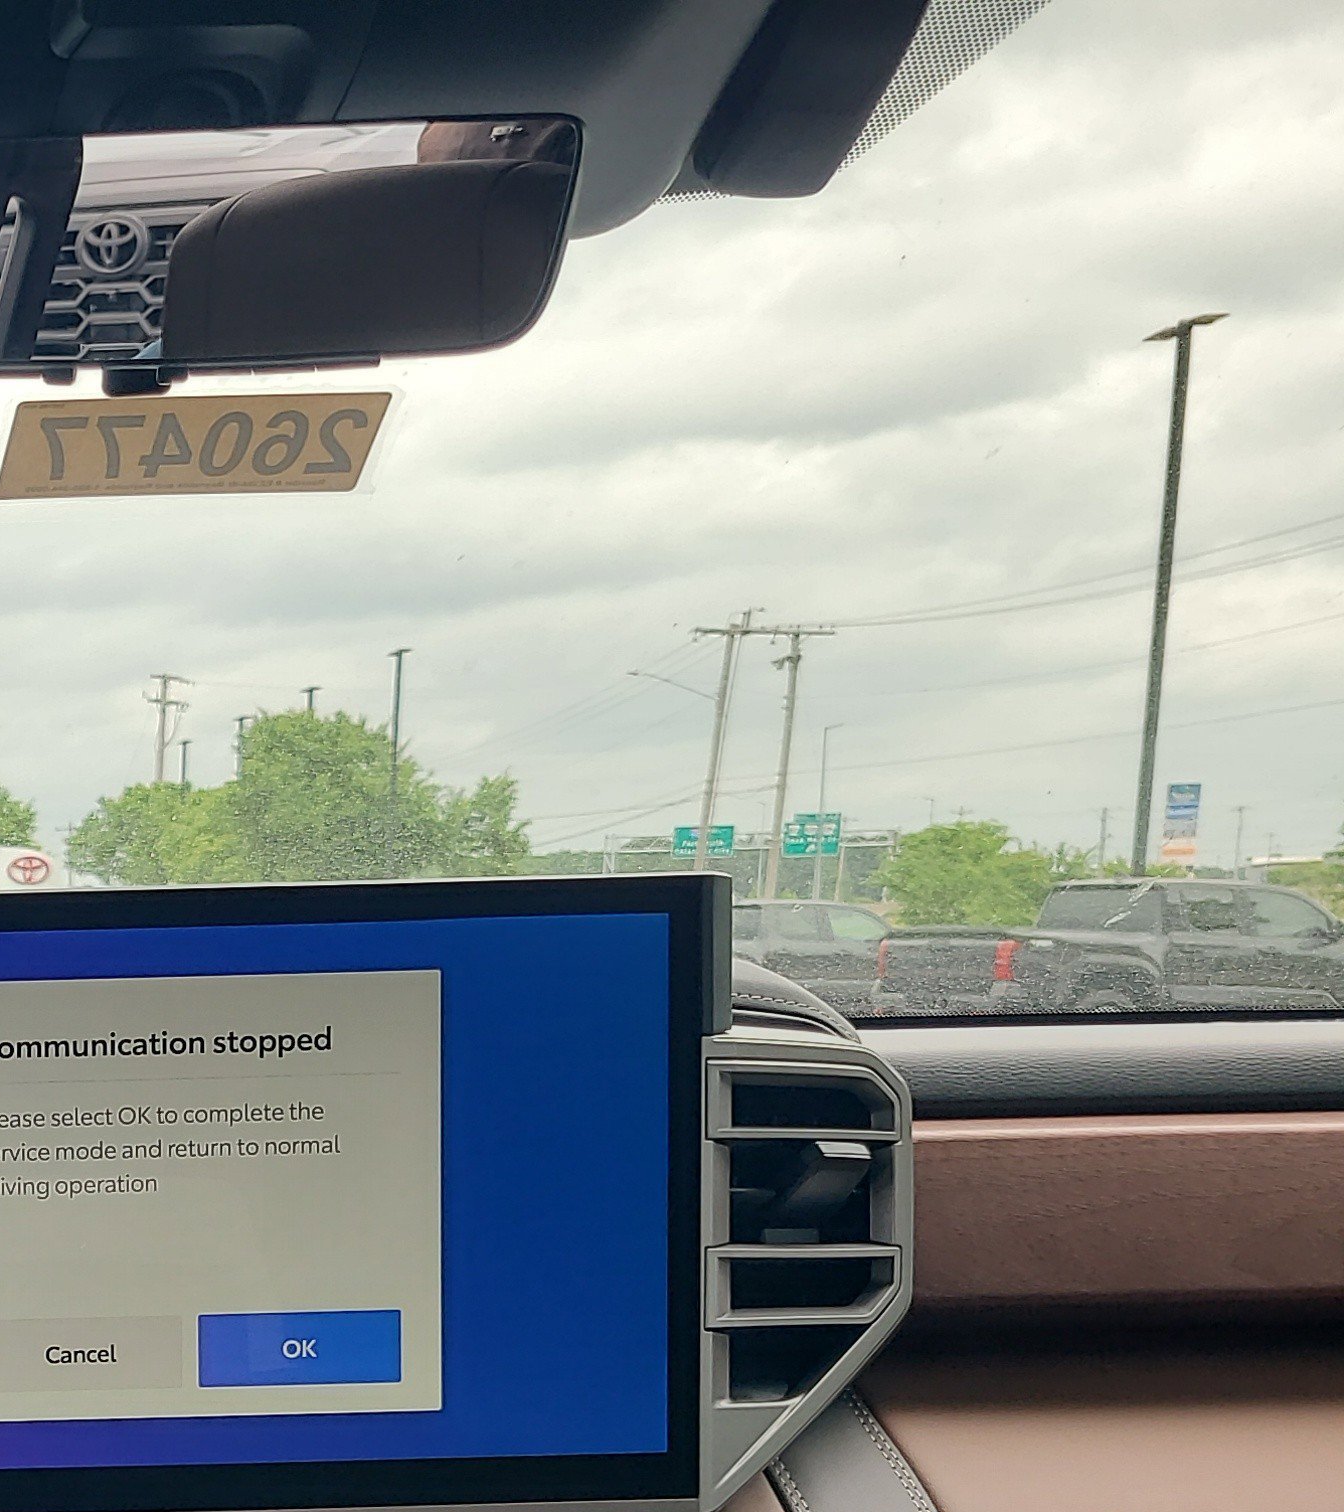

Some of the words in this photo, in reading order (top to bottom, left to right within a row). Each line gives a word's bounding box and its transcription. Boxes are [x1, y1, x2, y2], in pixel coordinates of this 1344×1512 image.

[212, 1026, 333, 1060] stopped
[50, 1107, 114, 1127] select
[118, 1106, 152, 1126] OK
[156, 1107, 178, 1125] to
[183, 1104, 286, 1128] complete
[289, 1102, 325, 1121] the
[55, 1140, 117, 1161] mode
[121, 1139, 162, 1160] and
[167, 1140, 232, 1158] return
[237, 1139, 259, 1156] to
[264, 1135, 341, 1155] normal
[54, 1174, 158, 1198] operation
[45, 1343, 117, 1366] Cancel
[282, 1339, 317, 1360] OK
